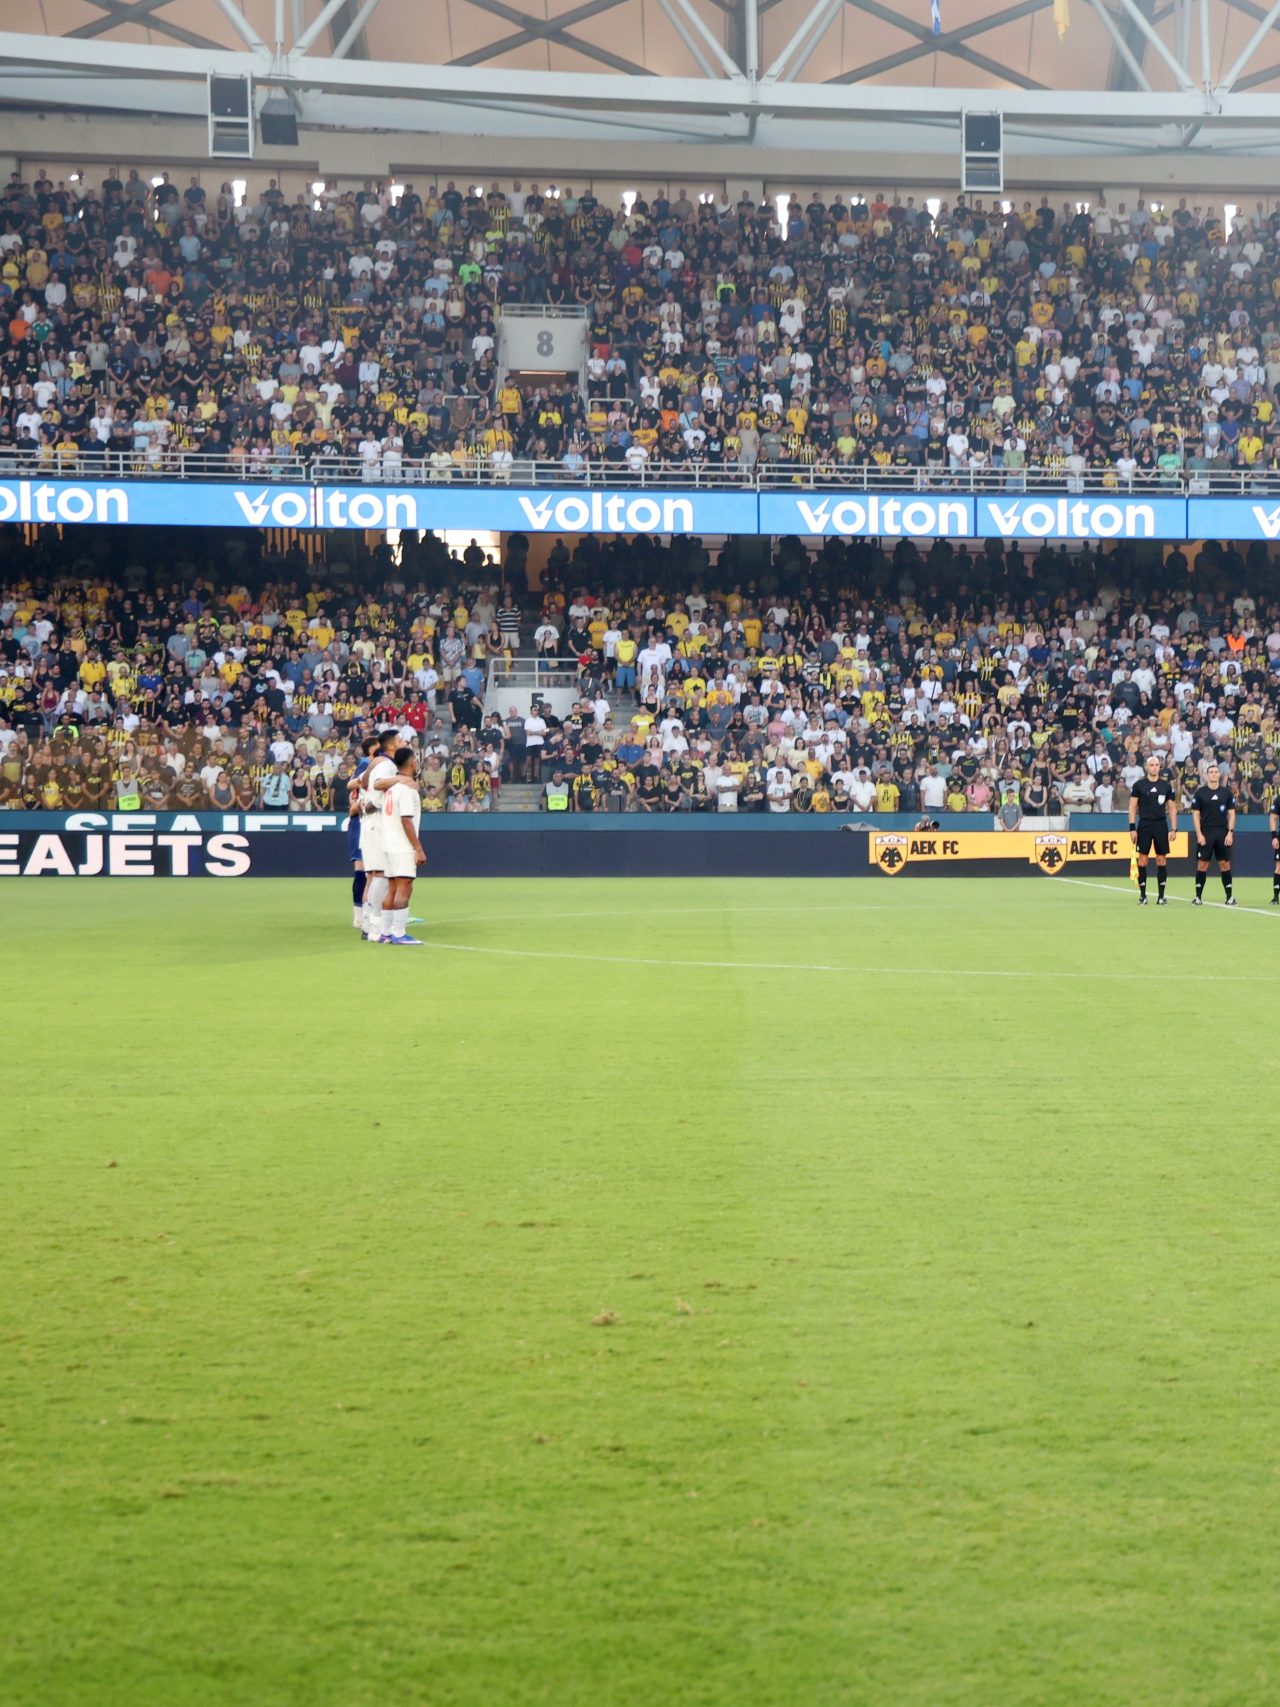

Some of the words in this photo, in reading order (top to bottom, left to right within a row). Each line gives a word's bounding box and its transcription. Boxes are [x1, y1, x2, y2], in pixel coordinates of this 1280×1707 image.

[537, 331, 554, 357] 8
[234, 487, 417, 531] volton
[519, 489, 694, 534] volton
[797, 495, 968, 536] volton
[988, 498, 1155, 537] volton
[910, 841, 937, 855] AEK
[942, 841, 959, 855] FC
[1070, 841, 1096, 855] AEK
[1102, 841, 1118, 855] FC
